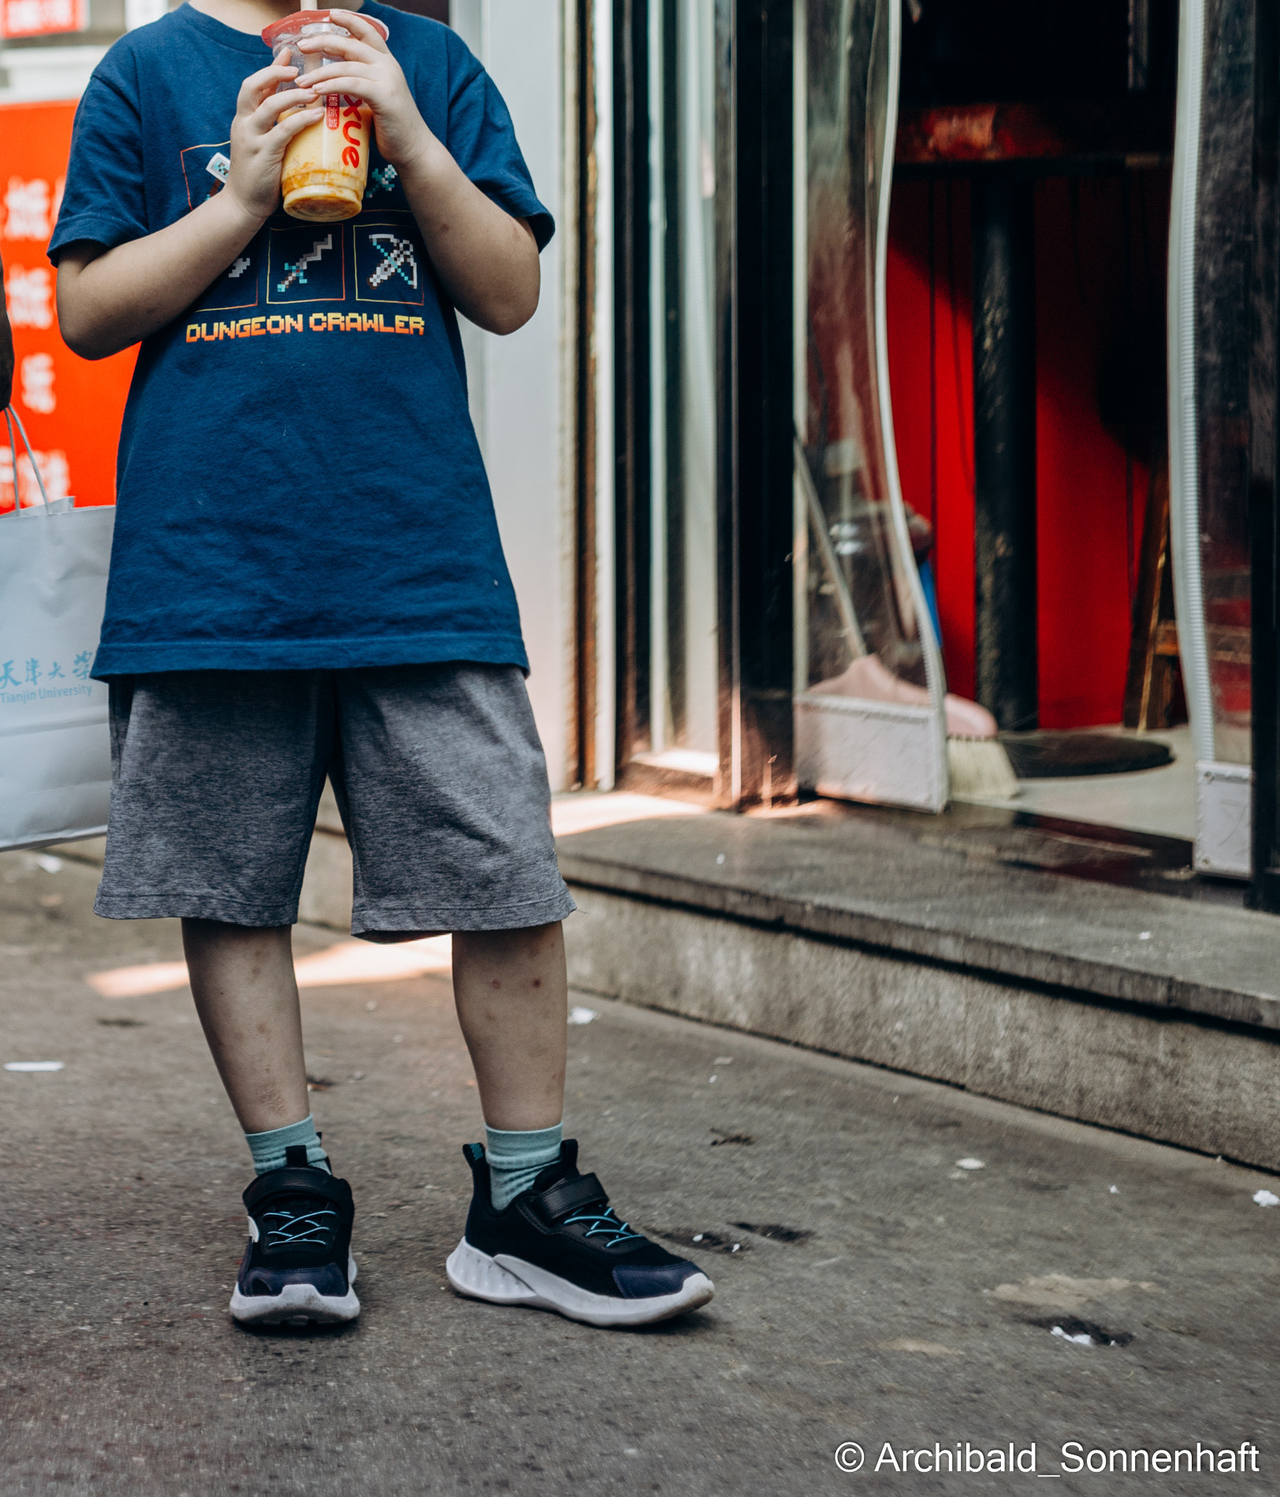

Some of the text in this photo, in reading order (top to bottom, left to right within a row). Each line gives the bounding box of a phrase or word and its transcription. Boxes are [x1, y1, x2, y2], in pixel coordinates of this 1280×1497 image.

[327, 93, 339, 128] 雪冰城
[186, 312, 425, 343] DUNGEON CRAWLER
[0, 684, 93, 704] Tianjin University
